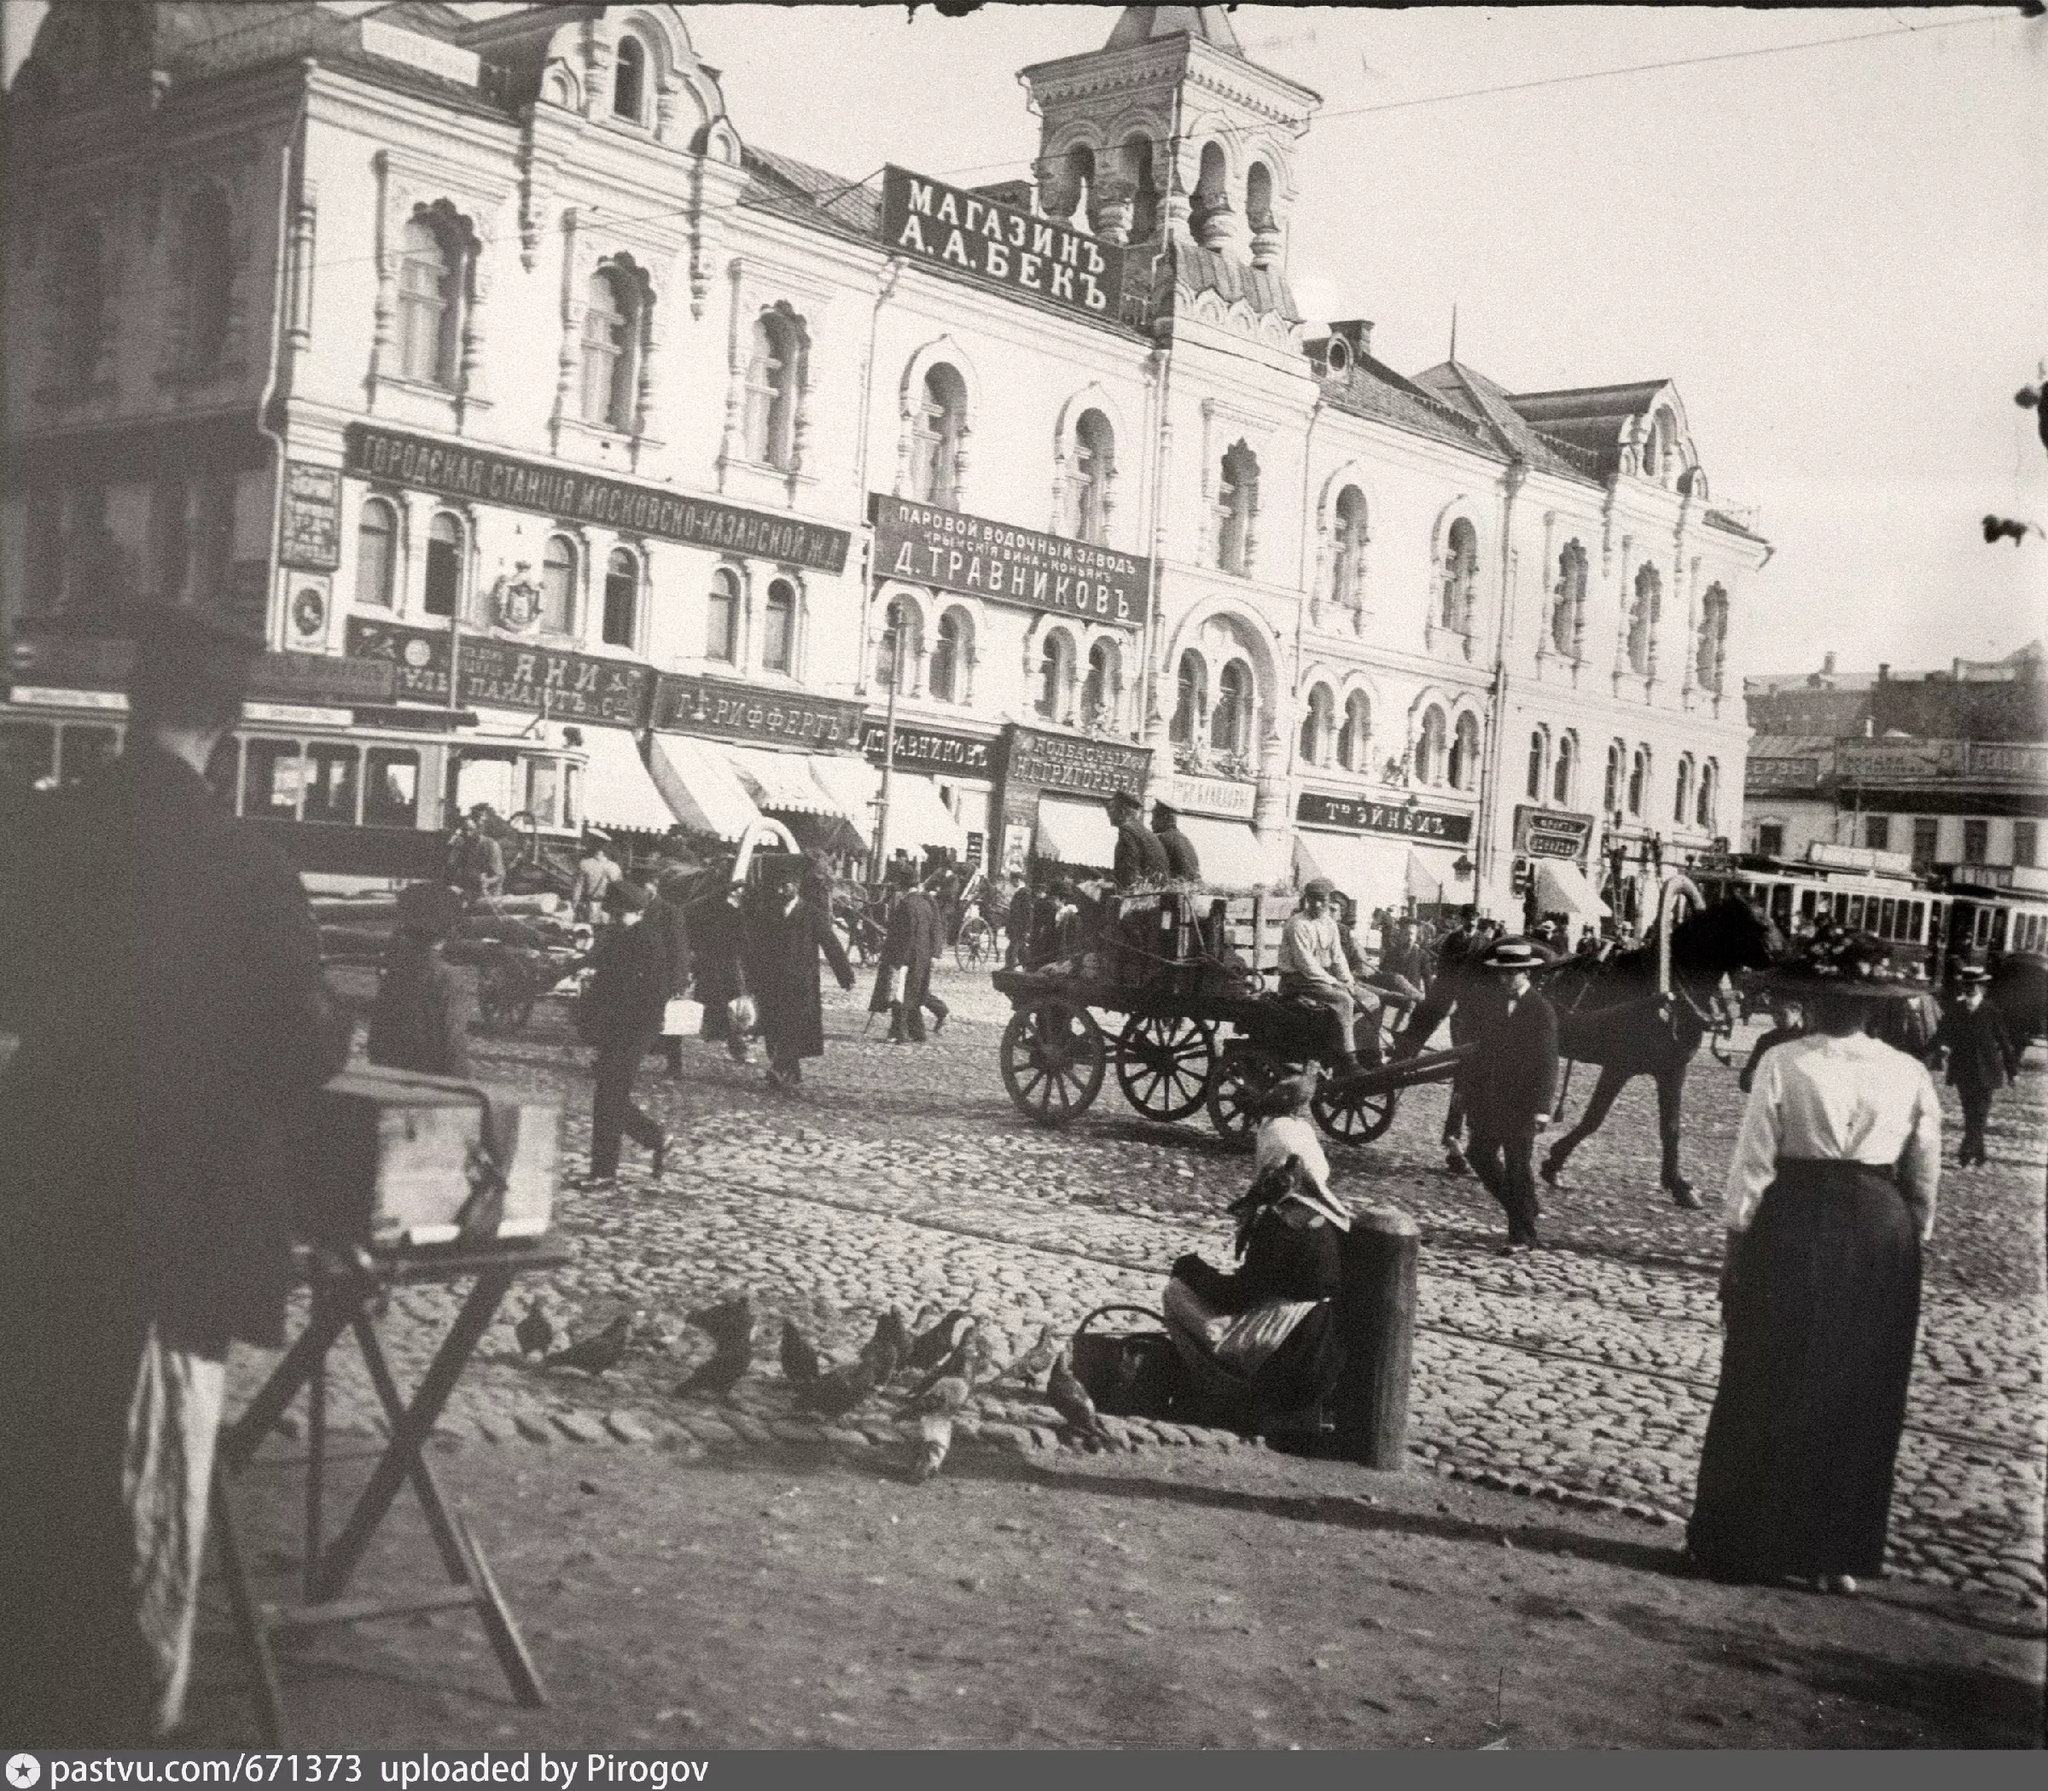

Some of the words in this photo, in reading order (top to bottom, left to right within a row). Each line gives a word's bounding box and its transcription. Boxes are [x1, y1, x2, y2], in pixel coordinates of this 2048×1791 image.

[908, 179, 1105, 273] МАГАЗИНЪ
[364, 435, 484, 494] ГОРОДСКАЯ
[900, 506, 978, 537] ПАРОВОЙ
[984, 526, 1073, 560] ВОДОЧНЫЙ
[1077, 548, 1136, 574] ЗАВОДЪ
[1003, 549, 1039, 566] ВИНА
[929, 546, 1129, 618] ТРАВНИКОВЪ
[1357, 805, 1445, 834] ЭЙНЕМЪ
